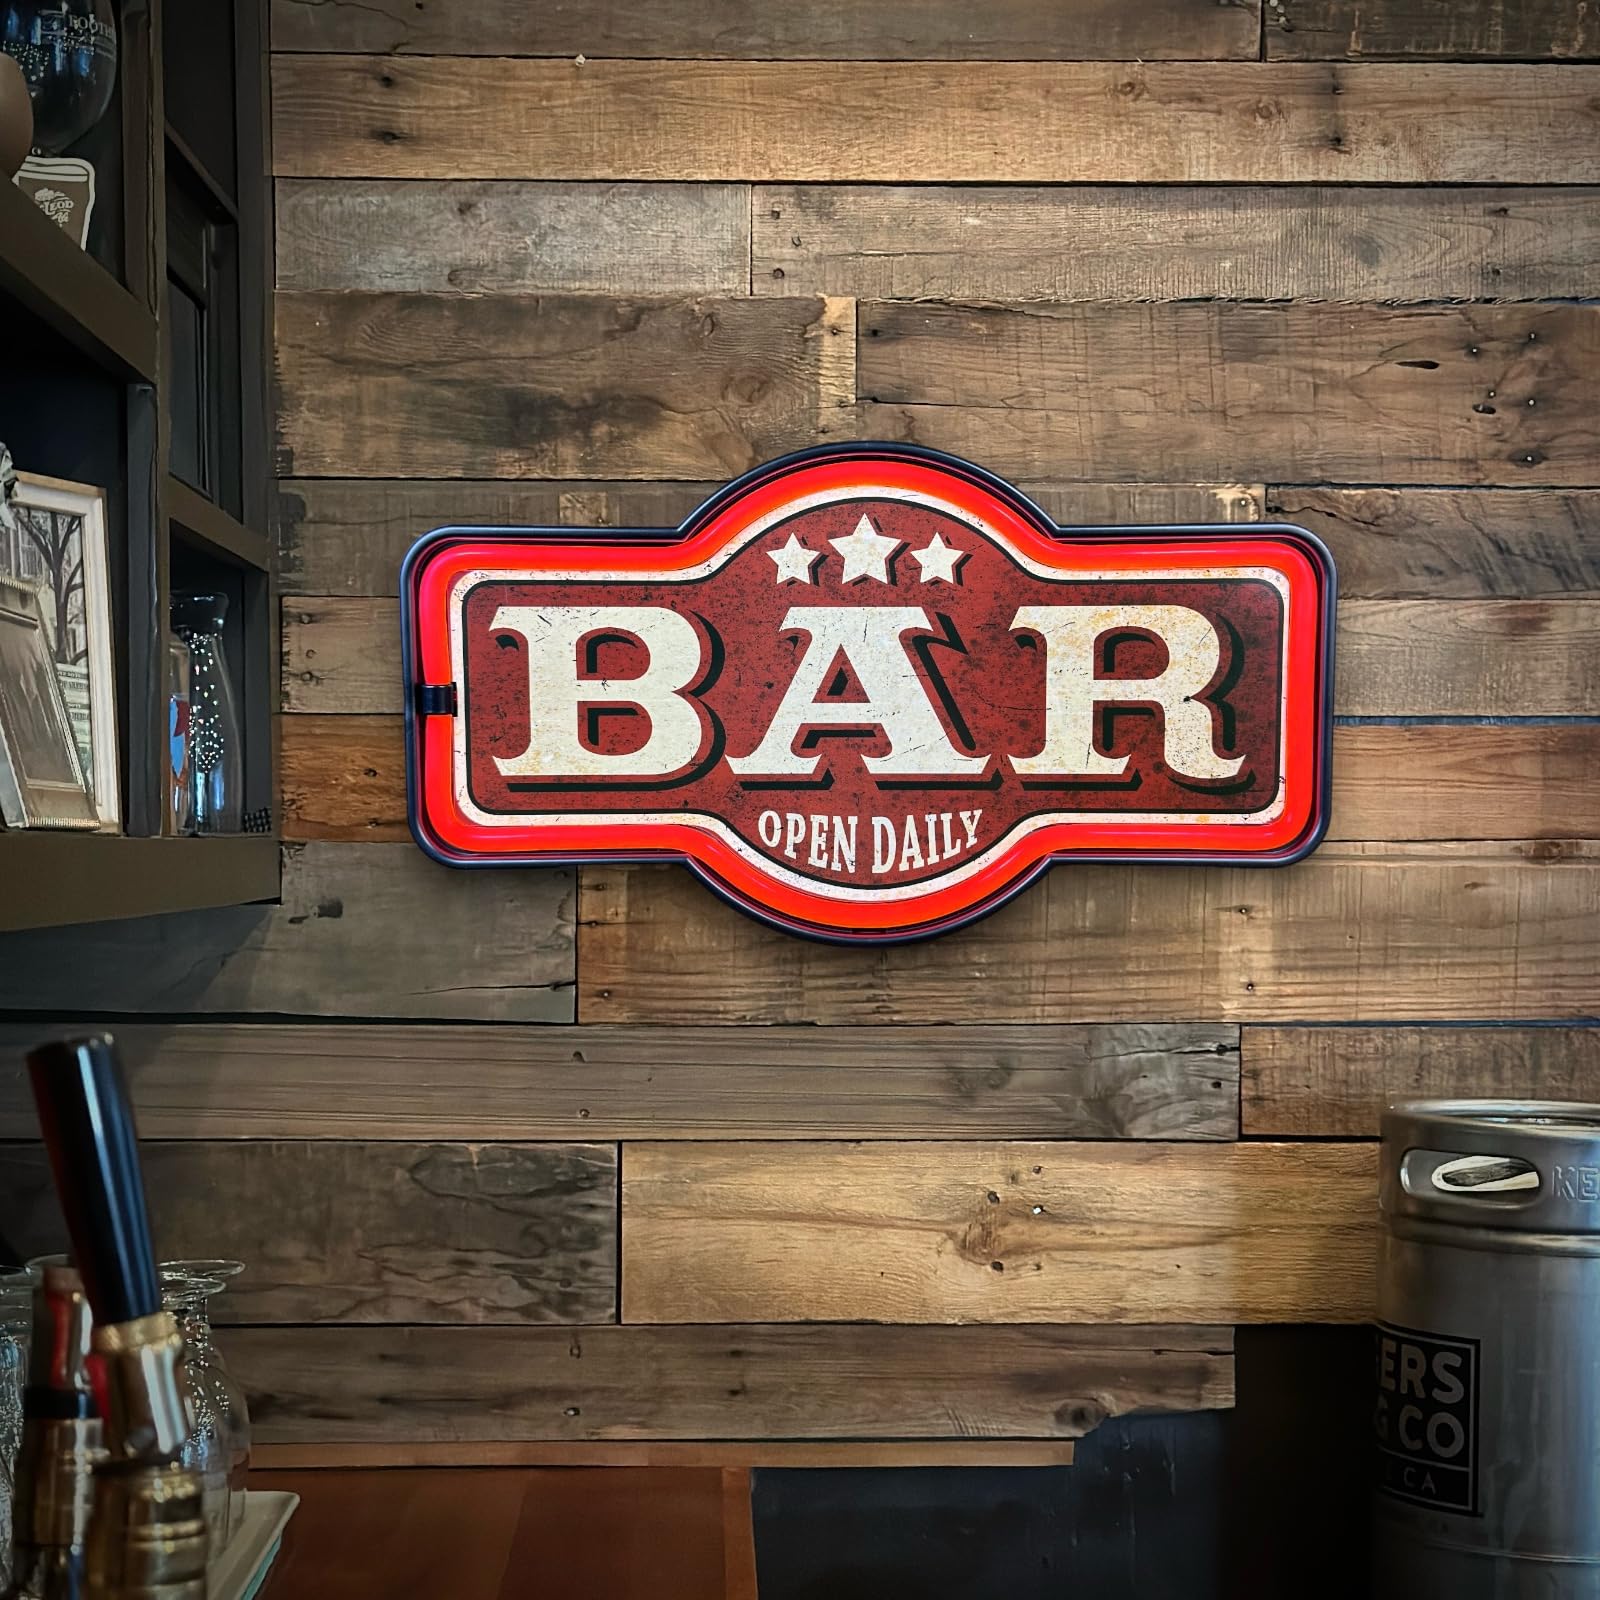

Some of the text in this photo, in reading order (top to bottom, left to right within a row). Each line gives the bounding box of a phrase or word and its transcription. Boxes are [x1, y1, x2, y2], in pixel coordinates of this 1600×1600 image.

[41, 200, 74, 215] LEOD
[488, 604, 1246, 779] BAR
[757, 809, 982, 874] OPEN DAILY
[1551, 1165, 1600, 1202] KE
[1377, 1337, 1465, 1404] ERS
[1402, 1466, 1438, 1496] CA
